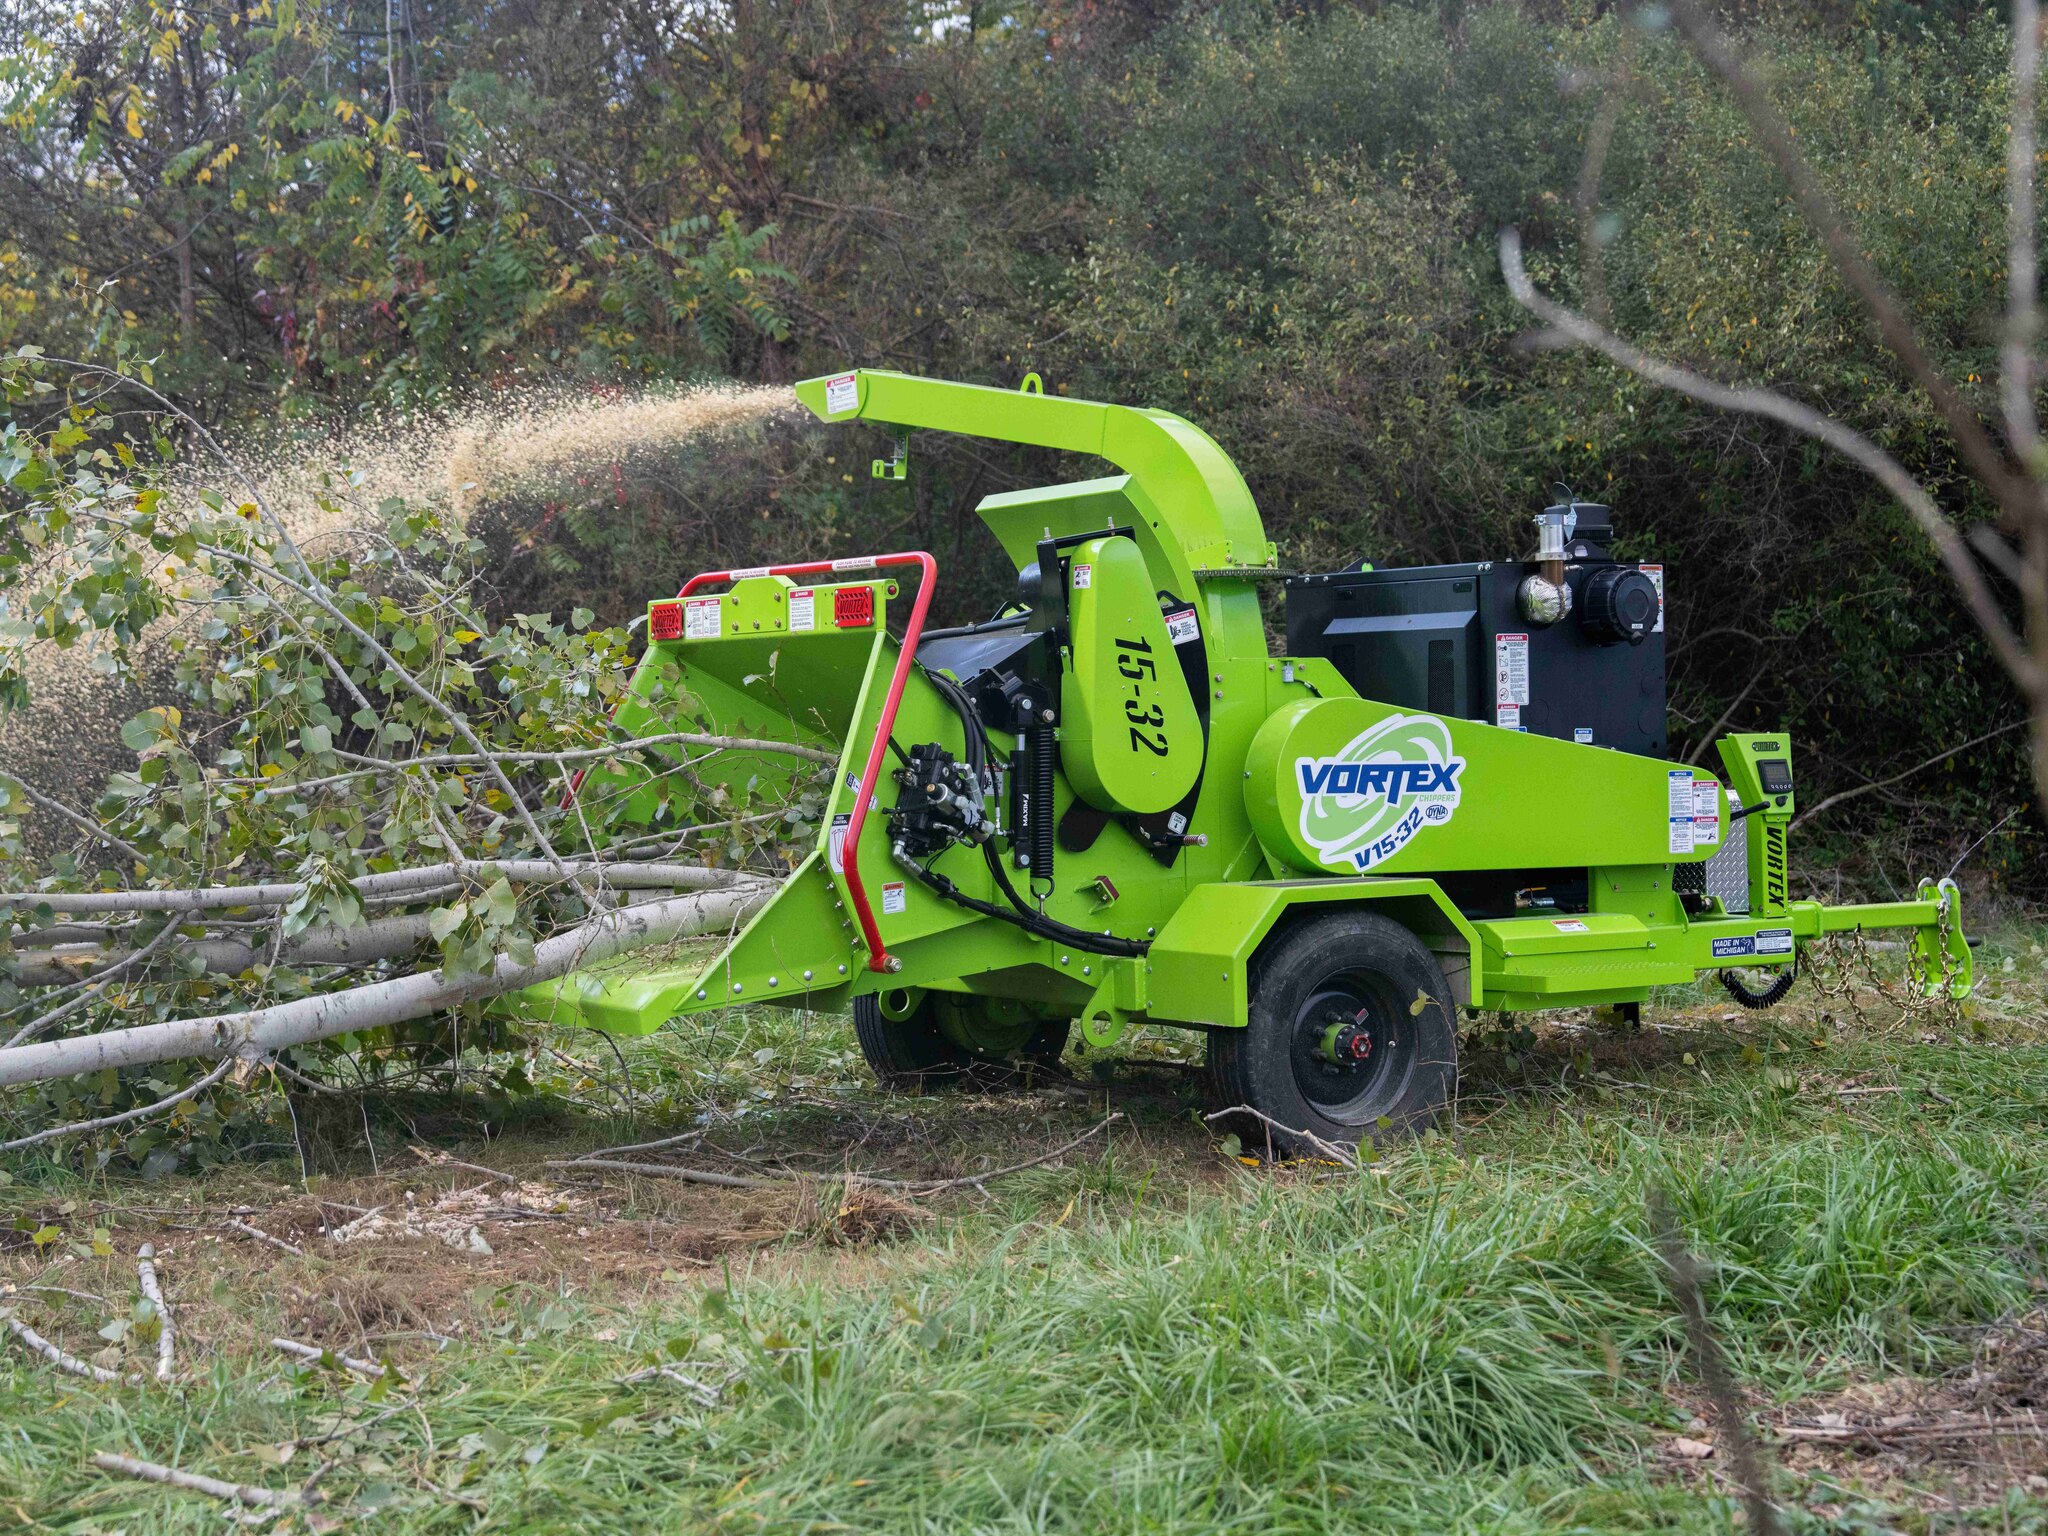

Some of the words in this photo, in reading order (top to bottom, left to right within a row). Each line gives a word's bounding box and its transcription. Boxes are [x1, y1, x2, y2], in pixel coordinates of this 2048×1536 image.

[1115, 636, 1168, 757] 15-32
[1301, 763, 1461, 805] VORTEX
[1419, 794, 1456, 802] CHIPPERS
[1428, 804, 1447, 820] DYNA
[1355, 806, 1424, 868] V15-32
[1767, 826, 1785, 909] VORTEX
[1714, 940, 1732, 948] MADE
[1715, 946, 1746, 955] MICHIGAN
